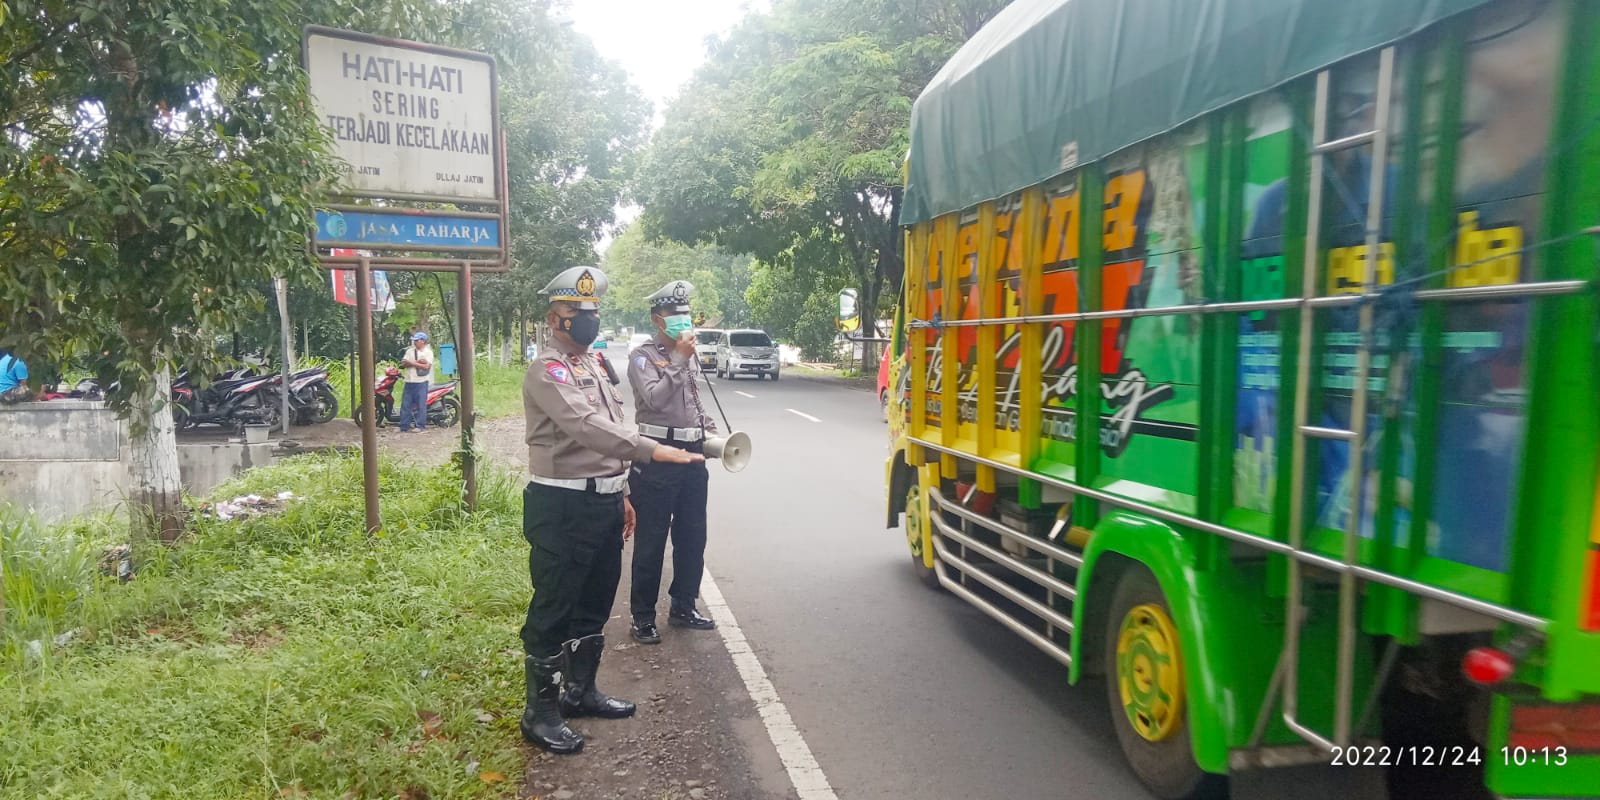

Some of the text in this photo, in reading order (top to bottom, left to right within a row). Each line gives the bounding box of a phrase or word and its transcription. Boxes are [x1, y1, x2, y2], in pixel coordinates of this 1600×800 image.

[342, 52, 463, 94] HATI-HATI
[373, 89, 439, 119] SERING
[327, 114, 489, 154] TERJADI KECELAKAAN
[358, 165, 381, 176] JATIM
[464, 175, 484, 184] JATIM
[416, 223, 490, 243] RAHARJA
